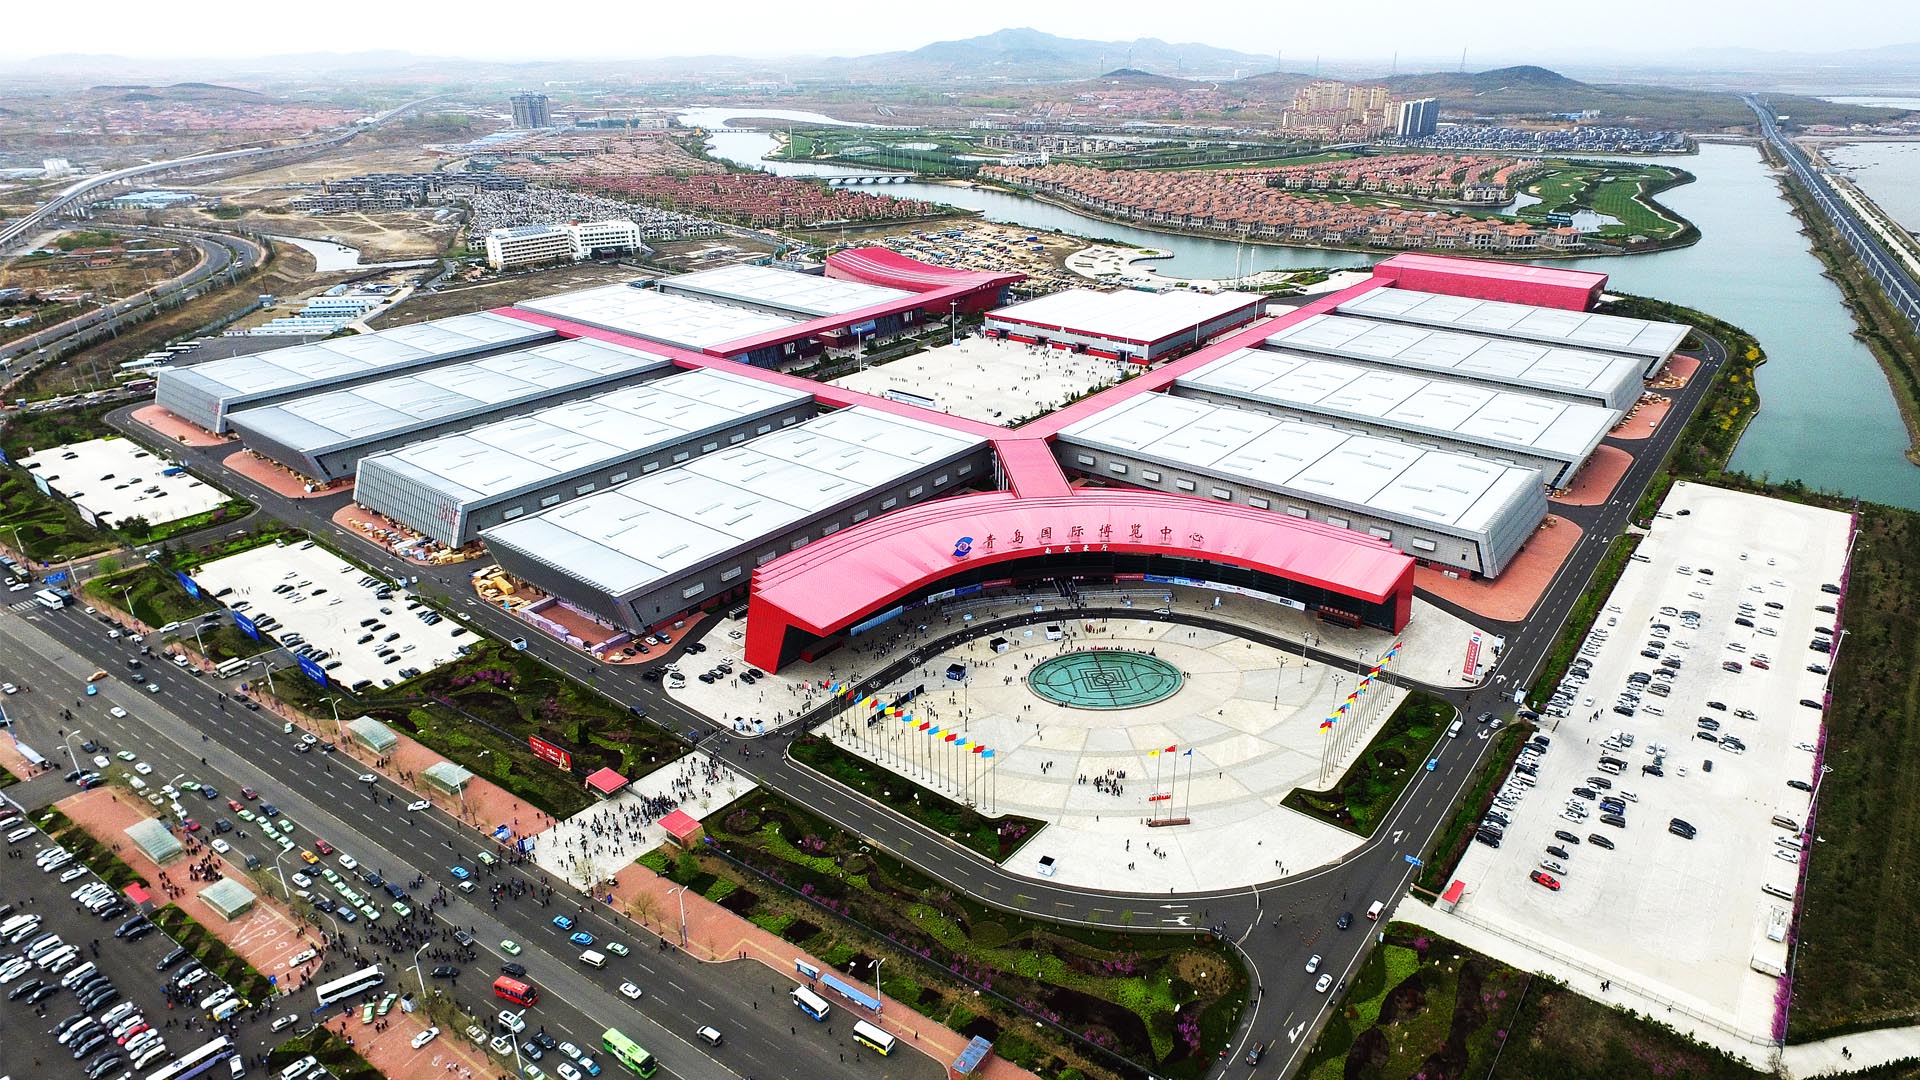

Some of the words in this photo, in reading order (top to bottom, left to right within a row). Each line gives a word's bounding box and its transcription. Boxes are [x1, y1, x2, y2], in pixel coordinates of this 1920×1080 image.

[903, 311, 913, 323] W1
[784, 342, 796, 355] W2
[983, 523, 1204, 549] 青岛国际博览中心
